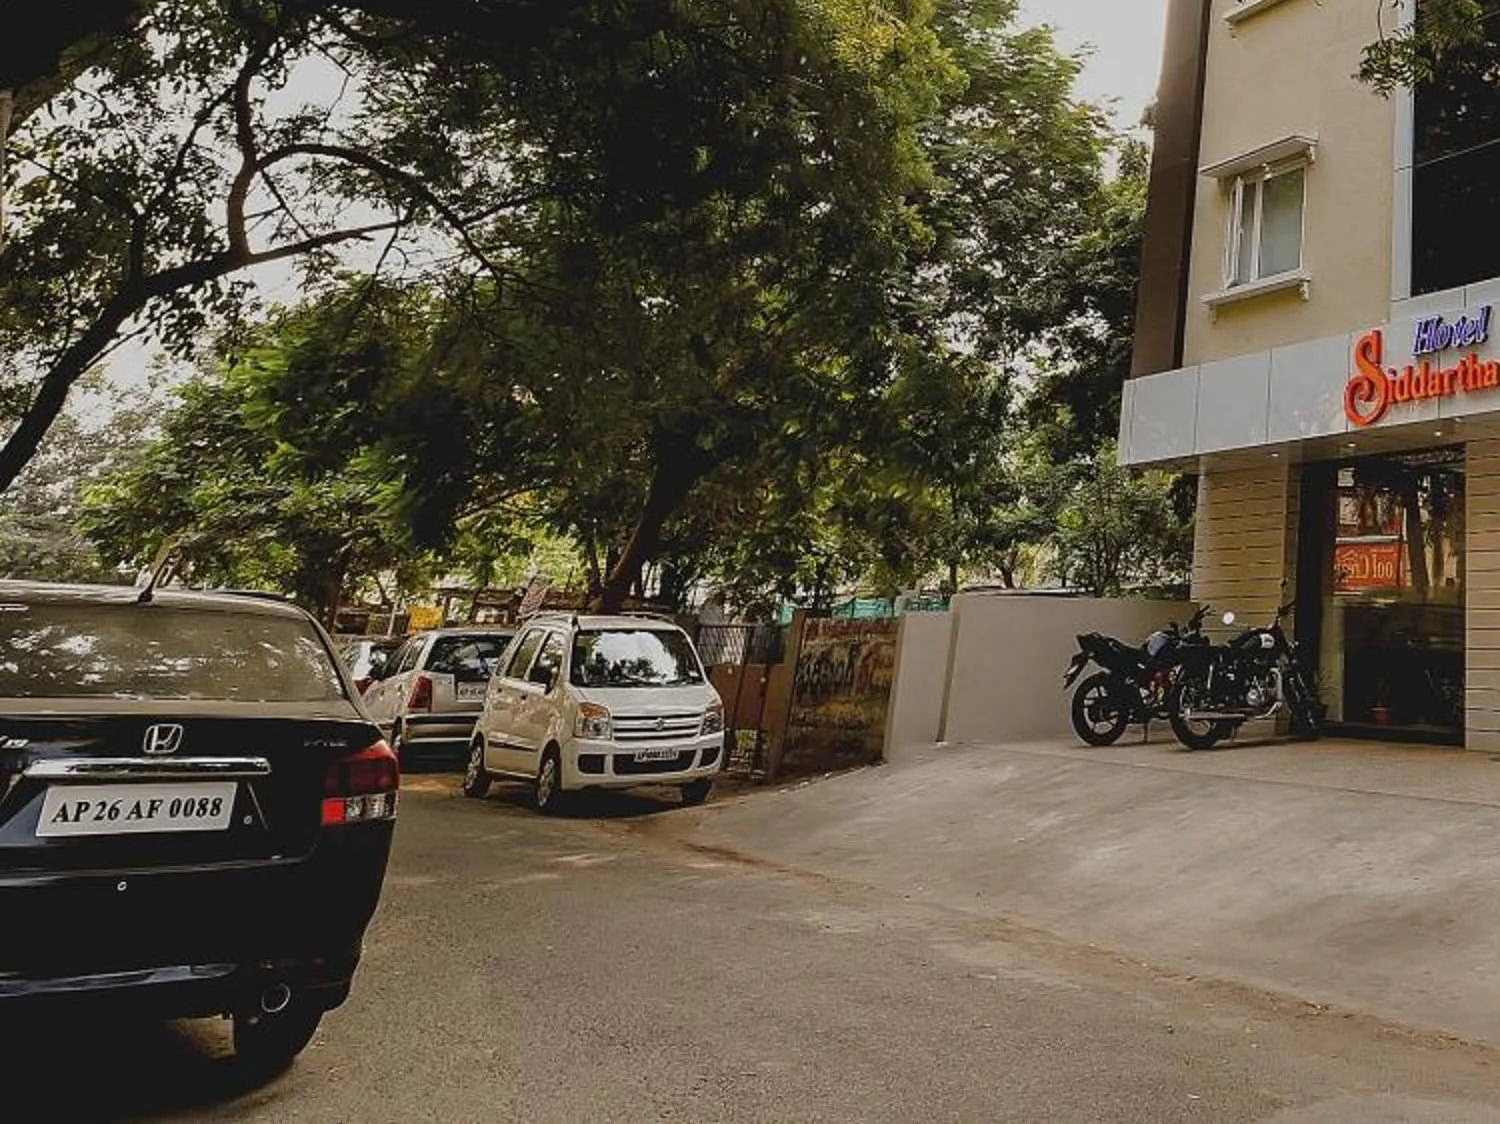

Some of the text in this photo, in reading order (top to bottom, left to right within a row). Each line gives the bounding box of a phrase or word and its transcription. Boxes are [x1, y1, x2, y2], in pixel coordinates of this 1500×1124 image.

[1413, 305, 1493, 357] Hotel
[51, 796, 223, 823] AP 26 AF 0088
